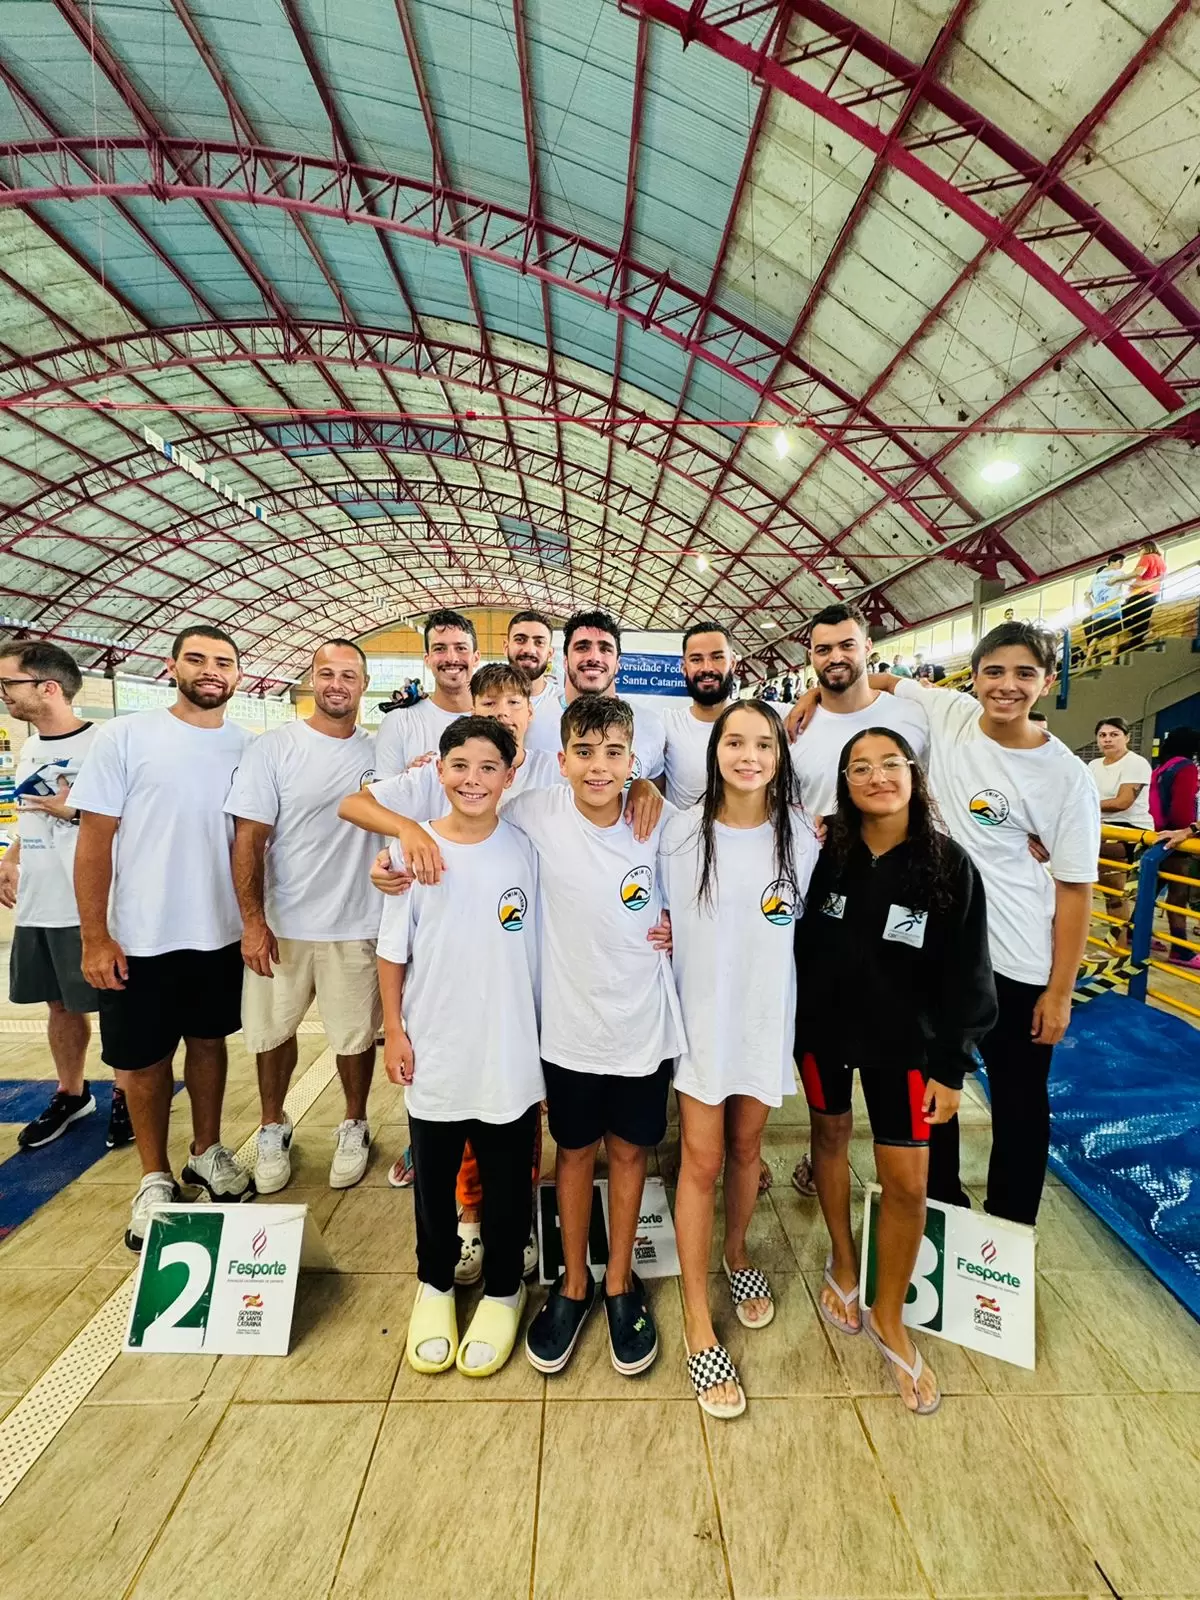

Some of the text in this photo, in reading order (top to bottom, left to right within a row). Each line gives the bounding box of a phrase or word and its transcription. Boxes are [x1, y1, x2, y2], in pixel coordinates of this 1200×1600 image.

[619, 661, 662, 673] versidade
[623, 675, 648, 686] Santa
[637, 1213, 663, 1224] orte
[228, 1260, 287, 1279] Fesporte
[957, 1256, 1021, 1288] Fesporte
[141, 1241, 212, 1348] 2
